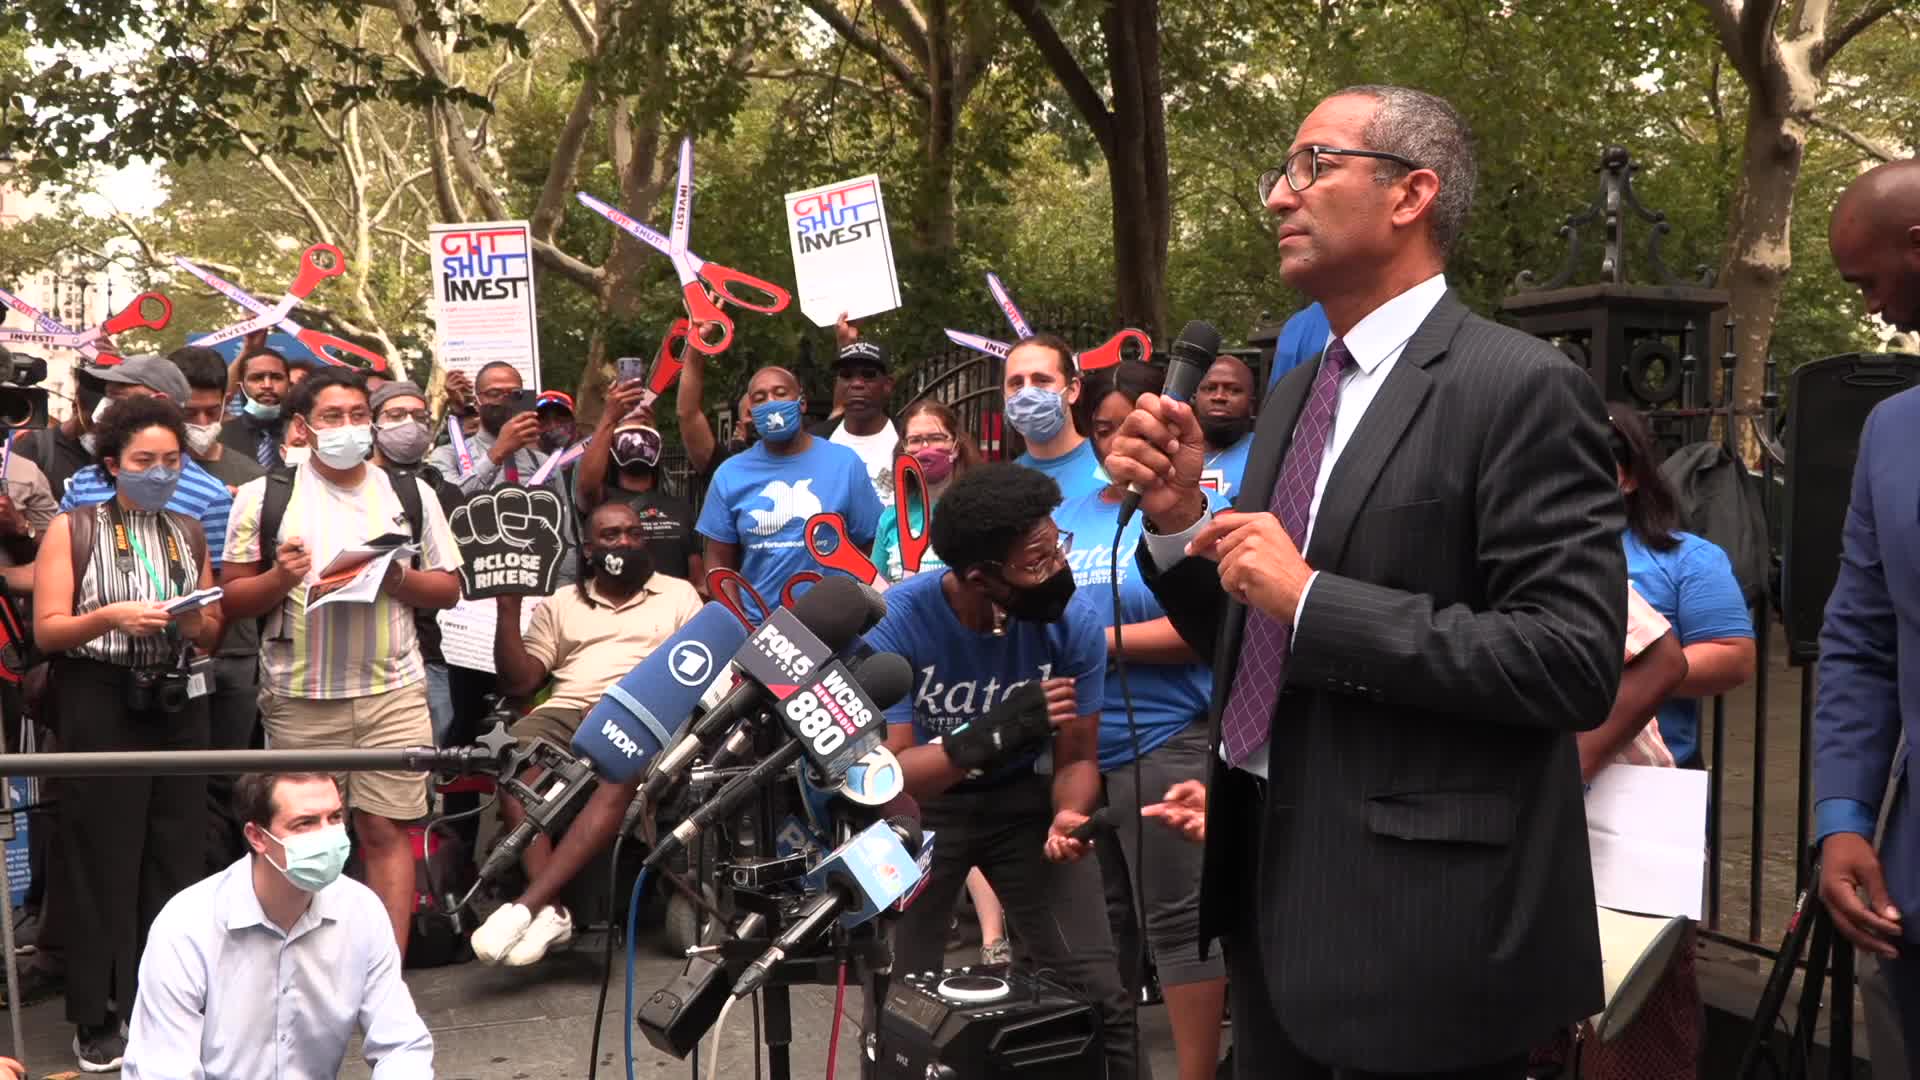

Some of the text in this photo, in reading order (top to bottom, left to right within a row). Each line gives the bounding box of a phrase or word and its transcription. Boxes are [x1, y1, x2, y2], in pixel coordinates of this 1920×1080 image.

[607, 209, 631, 227] CUT!
[676, 184, 688, 230] INVEST!
[797, 200, 876, 235] SHUT
[798, 218, 880, 254] INVEST
[443, 245, 527, 278] SHUT
[443, 272, 528, 302] INVEST
[9, 333, 55, 343] INVEST!
[473, 552, 541, 572] #CLOSE
[475, 569, 538, 589] RIKERS
[811, 682, 856, 735] NEWSRADIO
[822, 669, 872, 728] WCBS
[786, 691, 845, 756] 880
